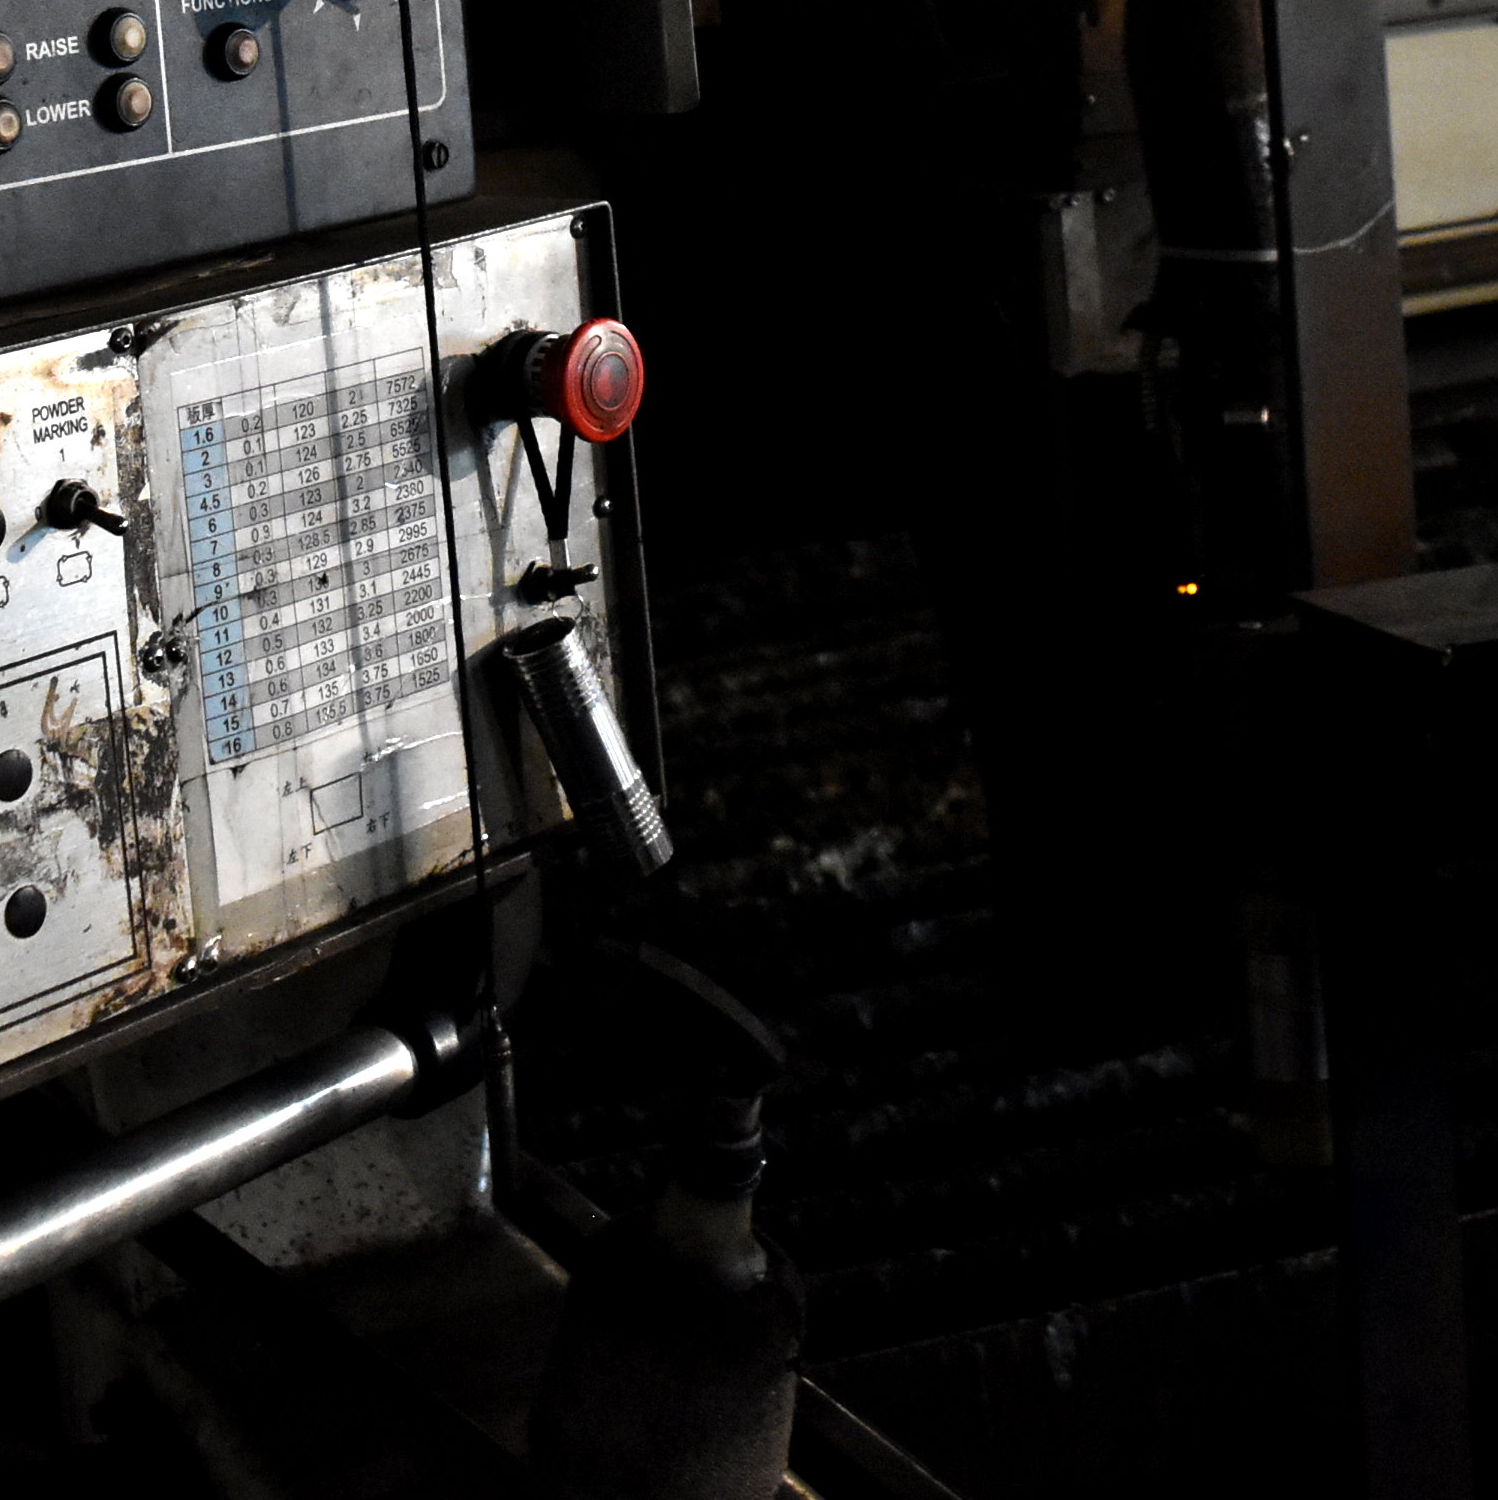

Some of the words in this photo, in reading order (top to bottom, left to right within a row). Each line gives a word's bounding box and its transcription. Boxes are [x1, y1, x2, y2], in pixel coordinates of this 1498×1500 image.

[26, 36, 80, 61] RAISE
[25, 100, 92, 128] LOWER
[32, 396, 85, 424] POWDER
[33, 416, 89, 445] MARKING
[187, 400, 215, 426] 板厚
[194, 427, 214, 445] 1.6
[242, 415, 262, 434] 0.2
[292, 402, 314, 420] 120
[201, 451, 210, 466] 2
[243, 437, 262, 455] 0.1
[294, 423, 316, 441] 123
[341, 409, 368, 429] 2.25
[388, 396, 418, 416] 7325
[58, 449, 66, 463] 1
[200, 493, 220, 511] 4.5
[247, 481, 267, 499] 0.2
[298, 466, 320, 484] 126
[345, 452, 371, 472] 2.75
[203, 474, 212, 489] 3
[245, 460, 264, 478] 0.1
[296, 444, 318, 463] 124
[347, 430, 366, 449] 2.5
[208, 518, 217, 534] 6
[249, 503, 269, 521] 0.3
[299, 488, 322, 506] 123
[356, 476, 364, 491] 2
[210, 540, 219, 555] 7
[251, 524, 271, 543] 0.3
[301, 509, 323, 528] 124
[352, 495, 370, 512] 3.2
[212, 562, 221, 578] 8
[351, 516, 376, 534] 2.85
[214, 584, 223, 600] 9
[306, 553, 328, 571] 129
[355, 538, 374, 556] 2.9
[399, 522, 428, 542] 2995
[212, 606, 229, 622] 10
[363, 560, 371, 576] 3
[401, 545, 430, 564] 2675
[214, 627, 231, 644] 11
[260, 613, 280, 630] 0.4
[309, 598, 331, 616] 131
[359, 581, 377, 598] 3.1
[403, 565, 431, 584] 2445
[216, 650, 232, 667] 12
[263, 634, 283, 652] 0.5
[312, 618, 333, 635] 132
[357, 600, 383, 620] 3.25
[405, 586, 433, 606] 2200
[219, 671, 235, 688] 13
[265, 656, 286, 674] 0.6
[314, 640, 335, 657] 133
[363, 624, 381, 641] 3.4
[406, 607, 435, 627] 2000
[223, 716, 240, 732] 15
[270, 699, 289, 717] 0.7
[318, 681, 340, 699] 135
[362, 666, 389, 684] 3.75
[410, 648, 439, 667] 1650
[268, 679, 288, 696] 0.6
[316, 661, 337, 678] 134
[365, 686, 391, 706] 3.75
[412, 669, 441, 688] 1525
